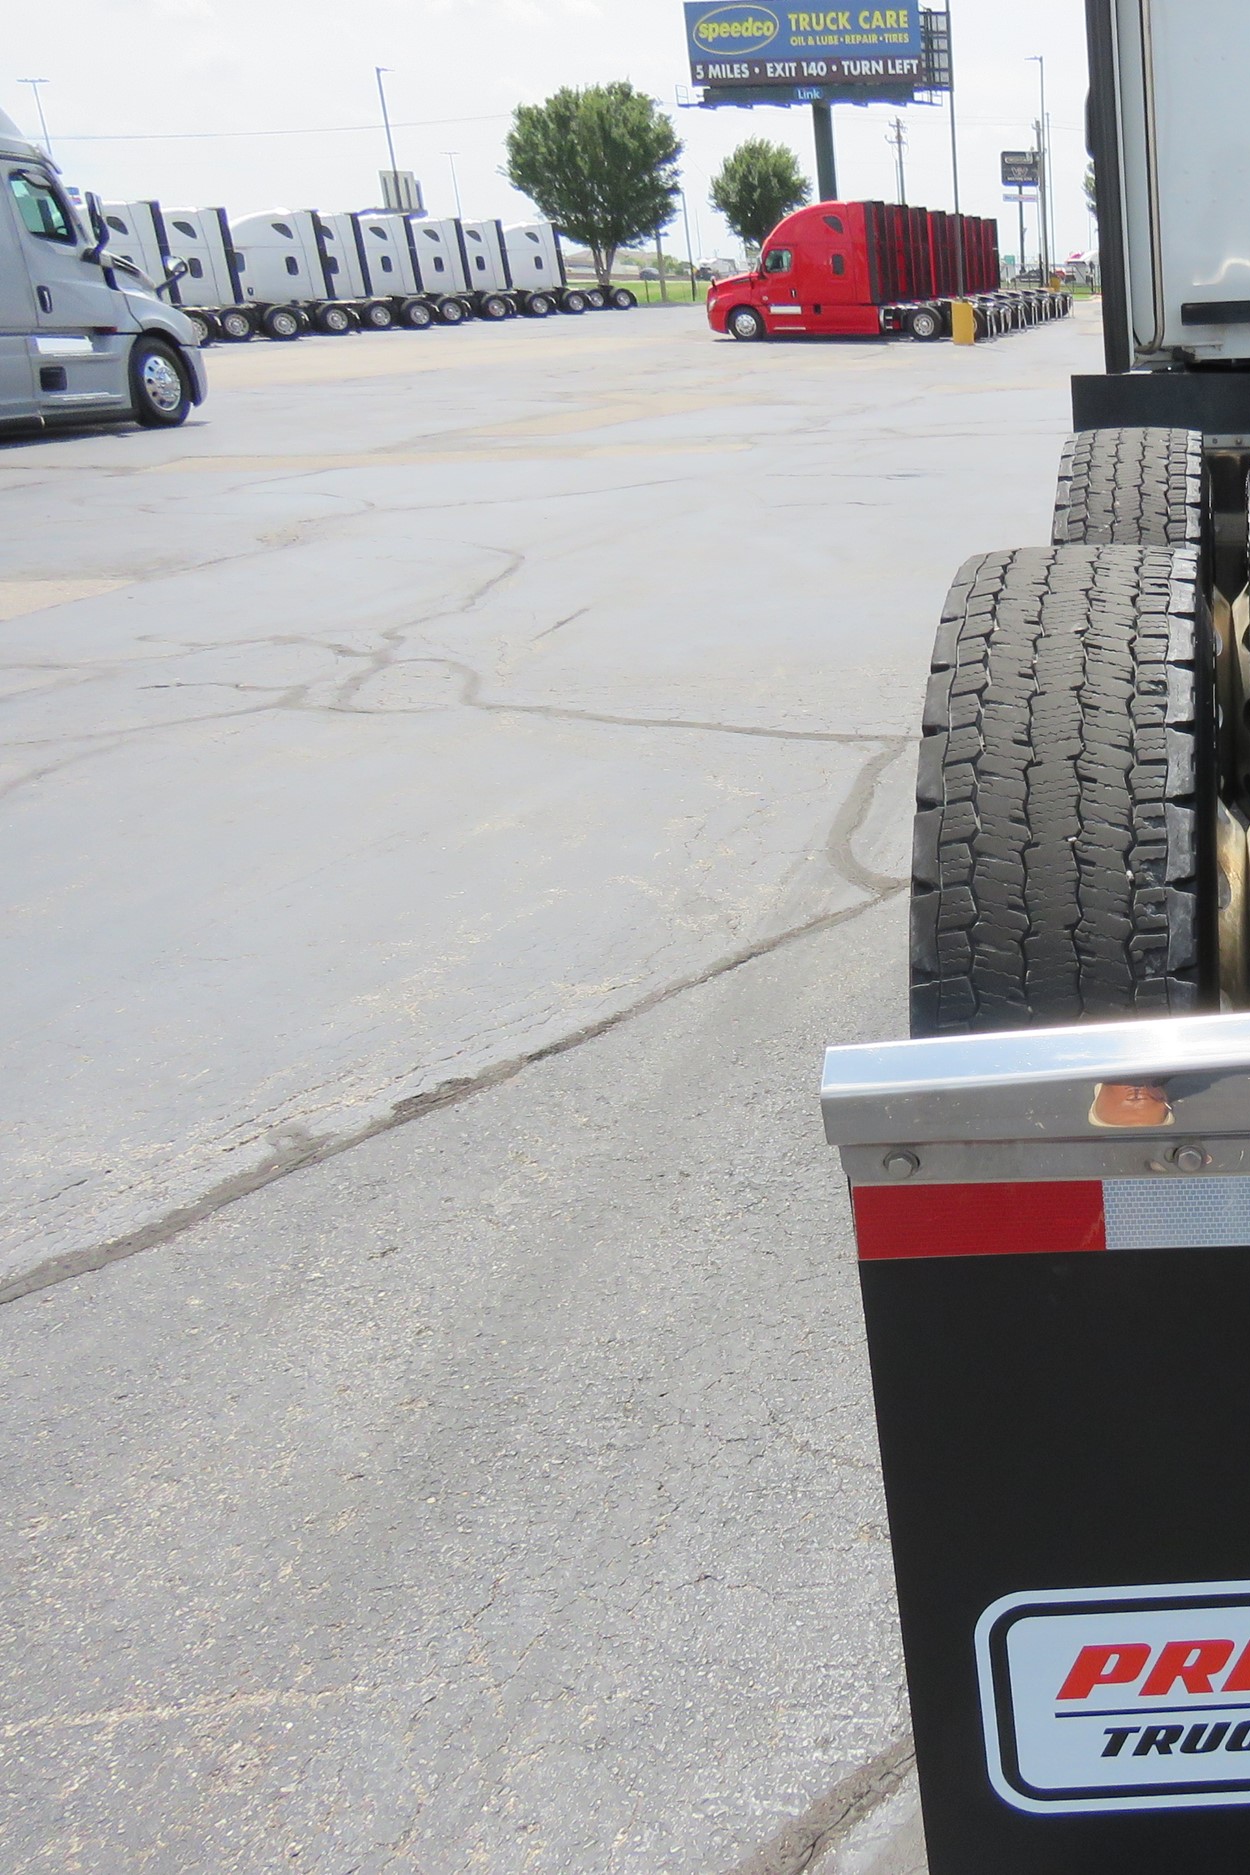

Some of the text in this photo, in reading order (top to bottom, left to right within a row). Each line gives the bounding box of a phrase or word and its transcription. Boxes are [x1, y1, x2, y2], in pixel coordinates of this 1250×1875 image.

[698, 17, 775, 42] speedco
[788, 9, 909, 31] TRUCK CARE
[790, 36, 806, 46] OIL
[817, 35, 839, 45] LUBE
[844, 33, 878, 45] REPAIR
[884, 33, 910, 43] TIRES
[696, 59, 919, 79] 5 MILES EXIT 140 TURN LEFT
[797, 87, 821, 100] Link
